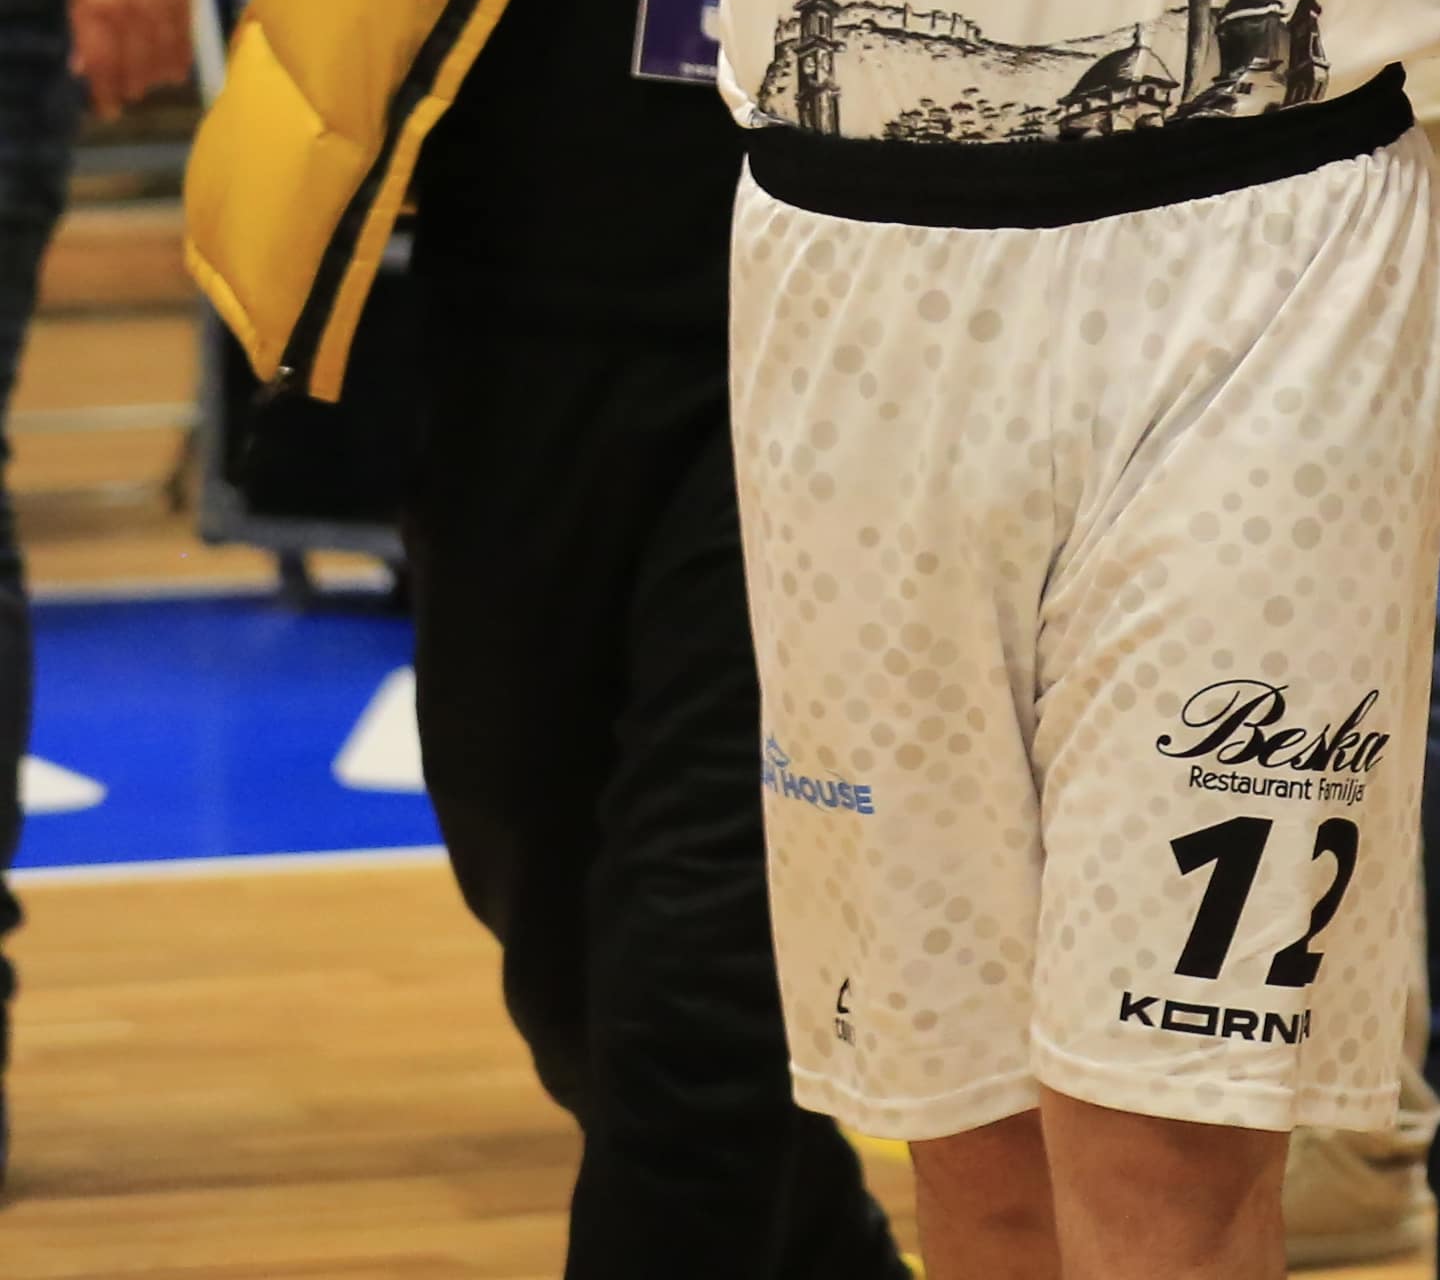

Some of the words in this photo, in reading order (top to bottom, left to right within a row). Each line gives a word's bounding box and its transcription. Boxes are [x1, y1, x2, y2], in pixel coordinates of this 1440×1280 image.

[1155, 679, 1391, 773] Beska
[782, 768, 875, 815] HOUSE
[1188, 765, 1313, 801] Restaurant
[1169, 815, 1360, 988] 12
